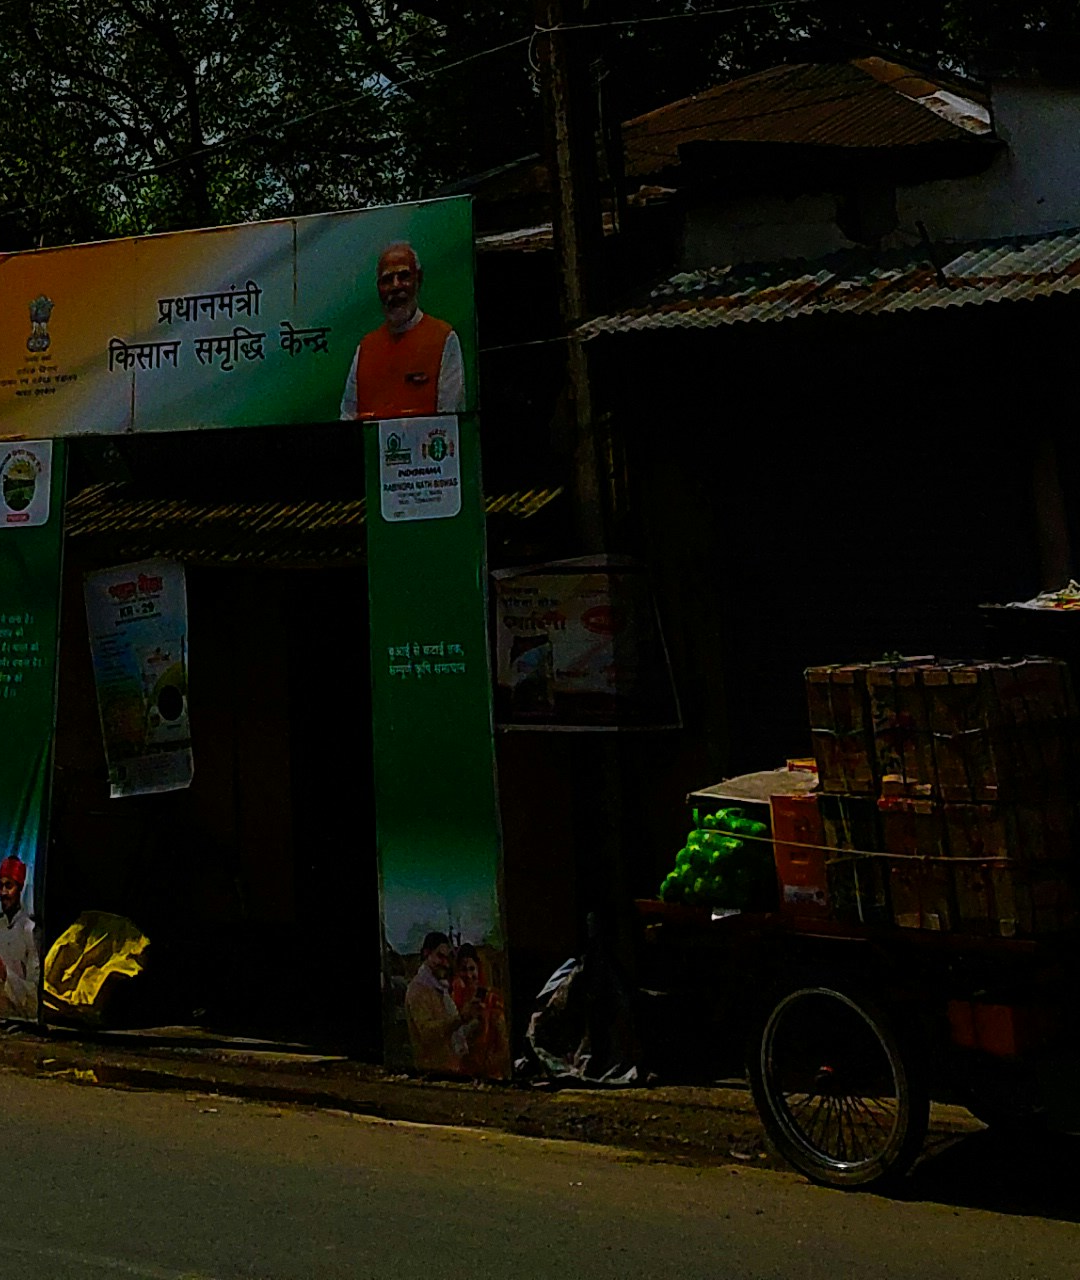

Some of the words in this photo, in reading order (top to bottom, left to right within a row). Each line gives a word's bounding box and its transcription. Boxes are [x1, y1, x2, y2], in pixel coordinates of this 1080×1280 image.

[158, 281, 262, 324] प्रधानमंत्री
[108, 337, 180, 372] किसान
[195, 326, 266, 372] समृद्धि
[279, 321, 332, 357] केन्द्र
[398, 466, 442, 478] INDORAMA
